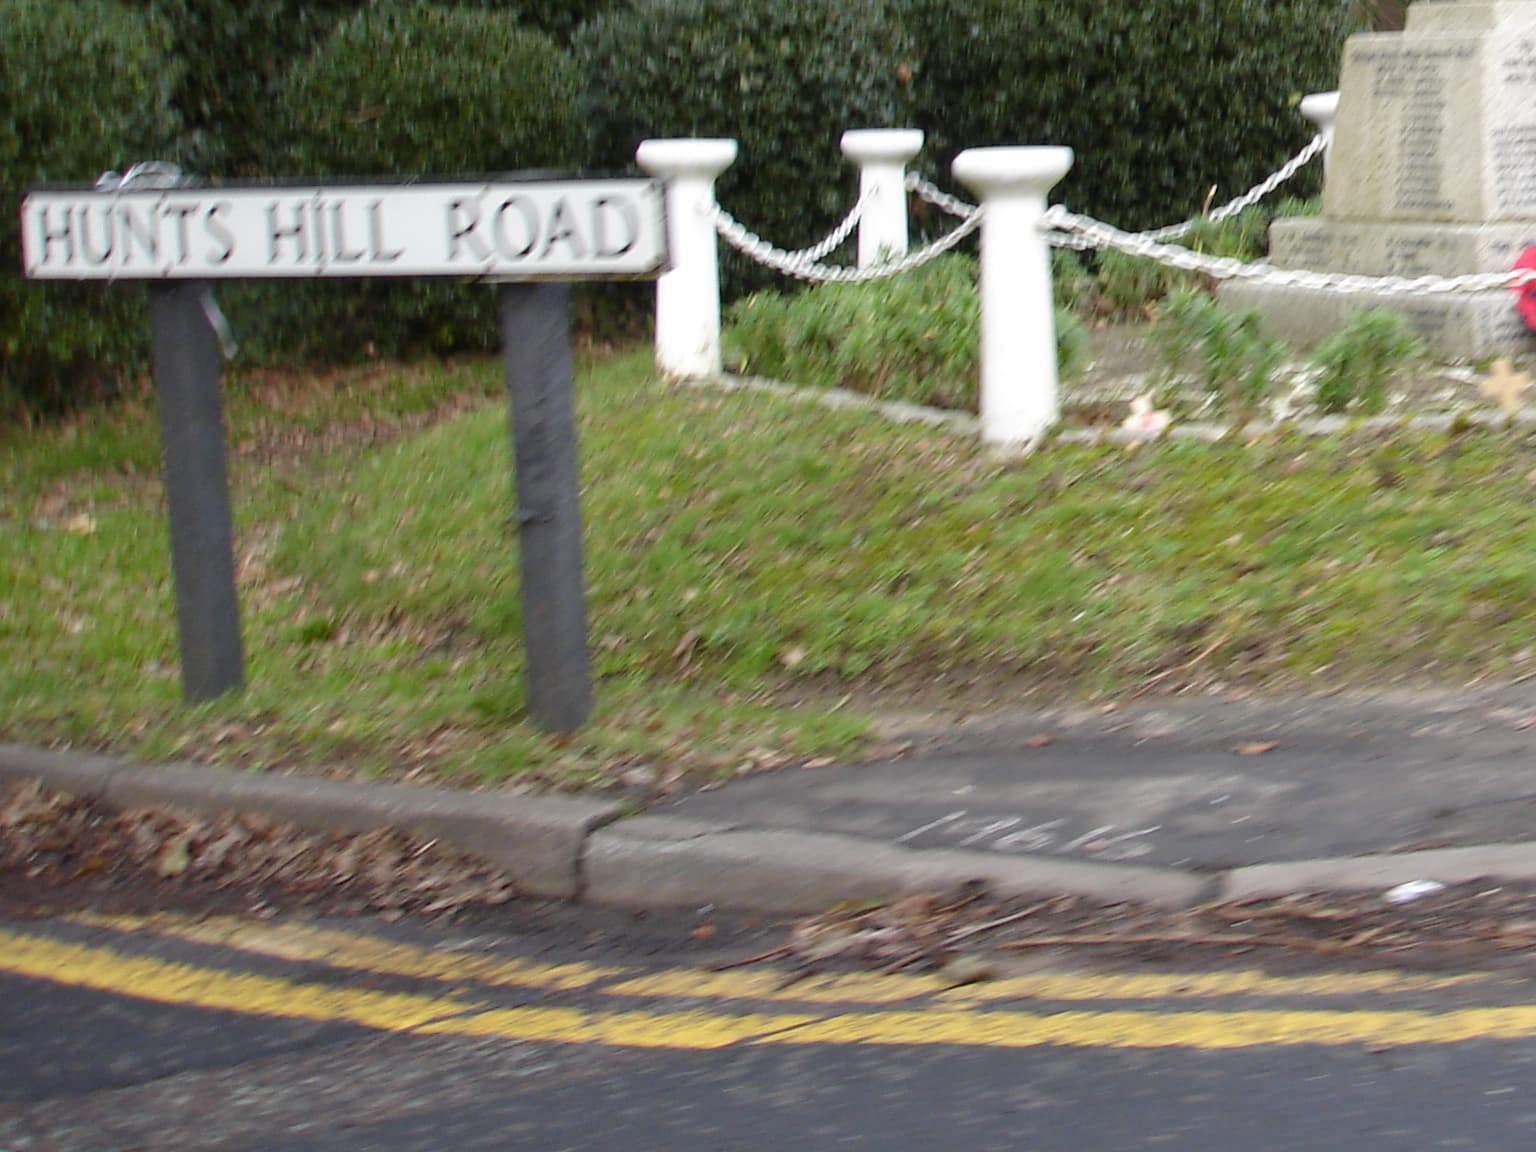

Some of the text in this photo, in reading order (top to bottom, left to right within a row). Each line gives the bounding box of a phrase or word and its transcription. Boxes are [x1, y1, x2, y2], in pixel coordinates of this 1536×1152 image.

[38, 194, 641, 266] HUNTS HILL ROAD
